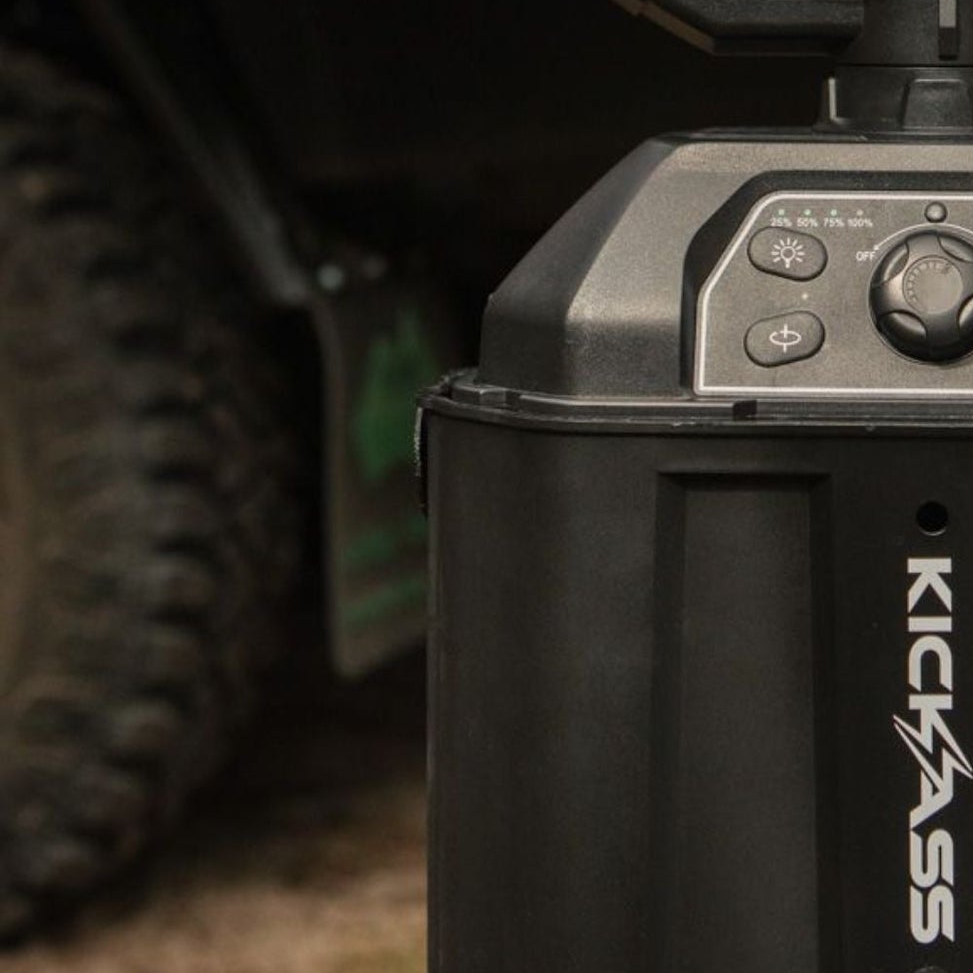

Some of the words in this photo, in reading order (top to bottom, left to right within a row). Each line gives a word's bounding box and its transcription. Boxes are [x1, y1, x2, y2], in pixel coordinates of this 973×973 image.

[770, 217, 793, 227] 25%
[797, 217, 818, 227] 50%
[823, 217, 845, 227] 75%
[847, 217, 873, 228] 100%
[855, 251, 876, 261] OFF
[893, 557, 973, 944] KICKASS
